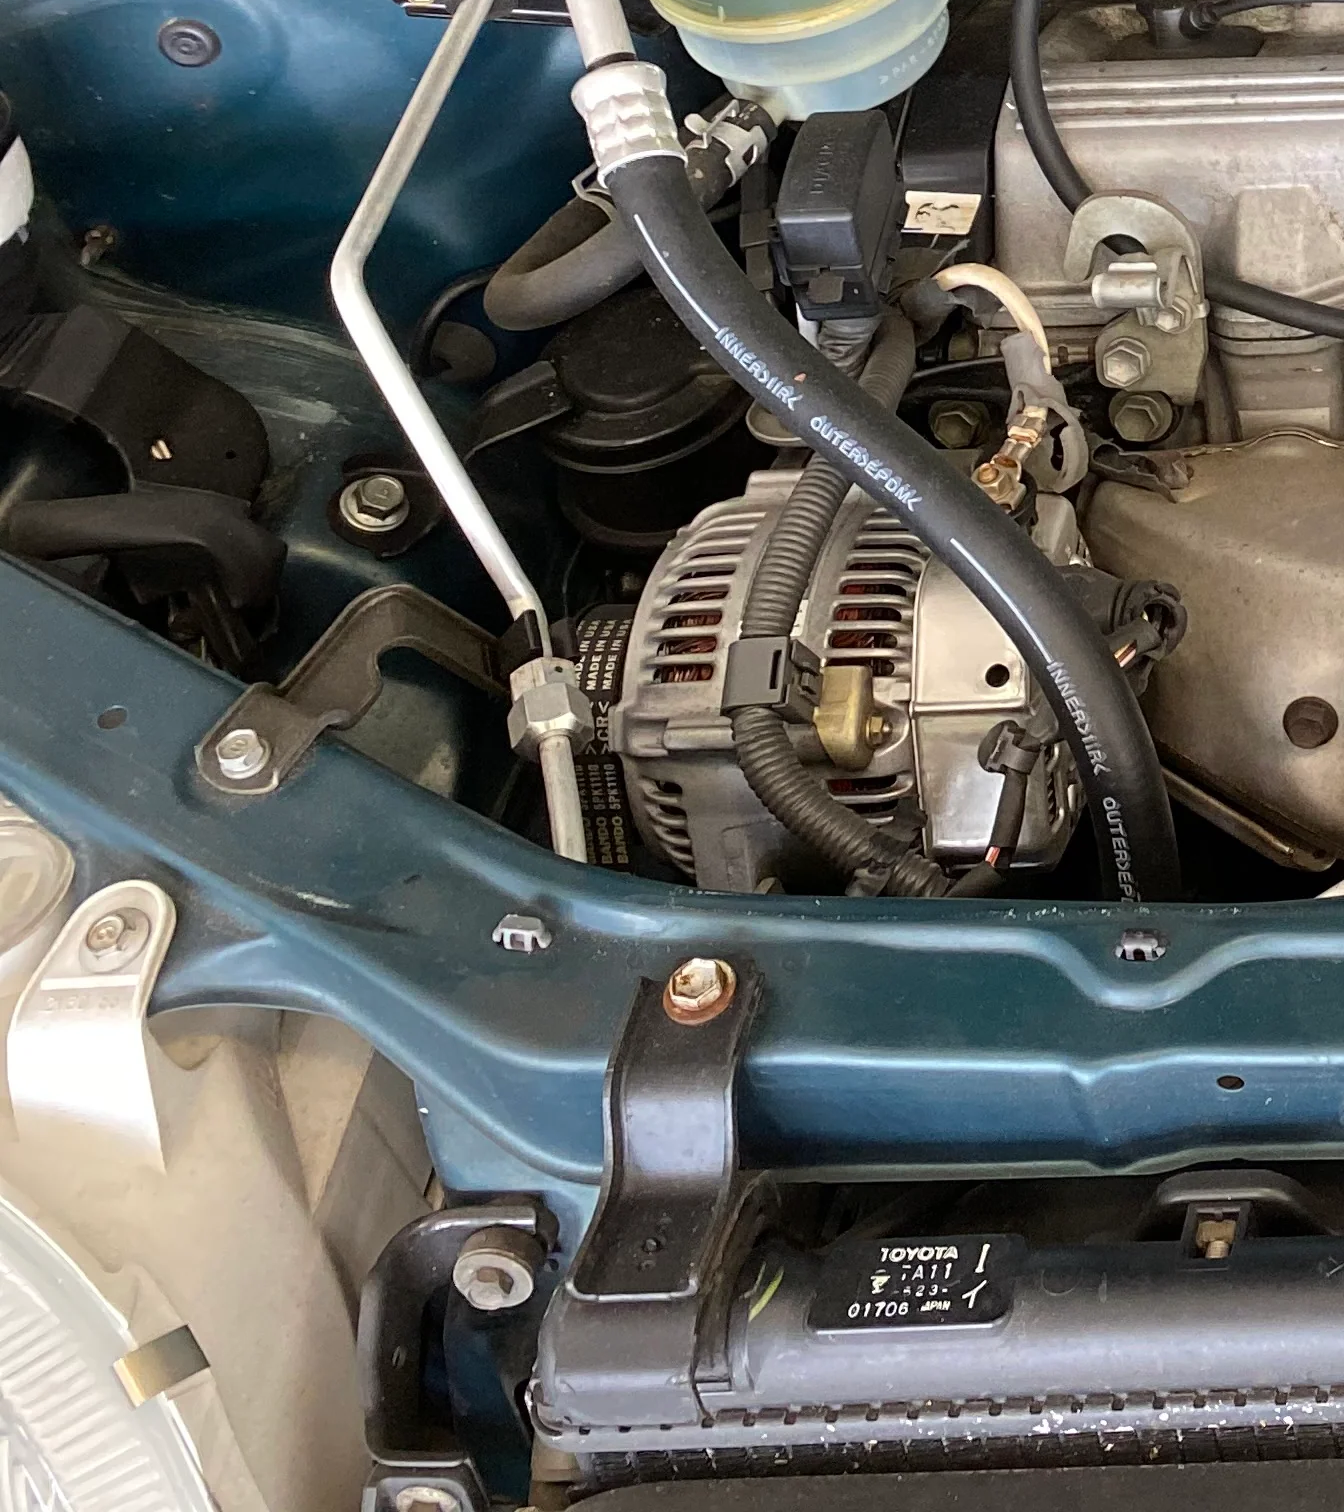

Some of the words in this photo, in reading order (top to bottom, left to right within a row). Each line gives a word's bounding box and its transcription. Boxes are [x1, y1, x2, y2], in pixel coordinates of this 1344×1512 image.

[600, 619, 618, 638] USA
[616, 618, 633, 638] USA
[594, 639, 607, 652] IN
[610, 638, 623, 651] IN
[586, 654, 602, 691] MADE
[602, 654, 618, 691] MADE
[603, 764, 622, 810] 5PK1110
[596, 816, 614, 864] BANDO
[611, 816, 629, 864] BANDO
[880, 1245, 959, 1263] TOYOTA
[847, 1301, 909, 1318] 01706
